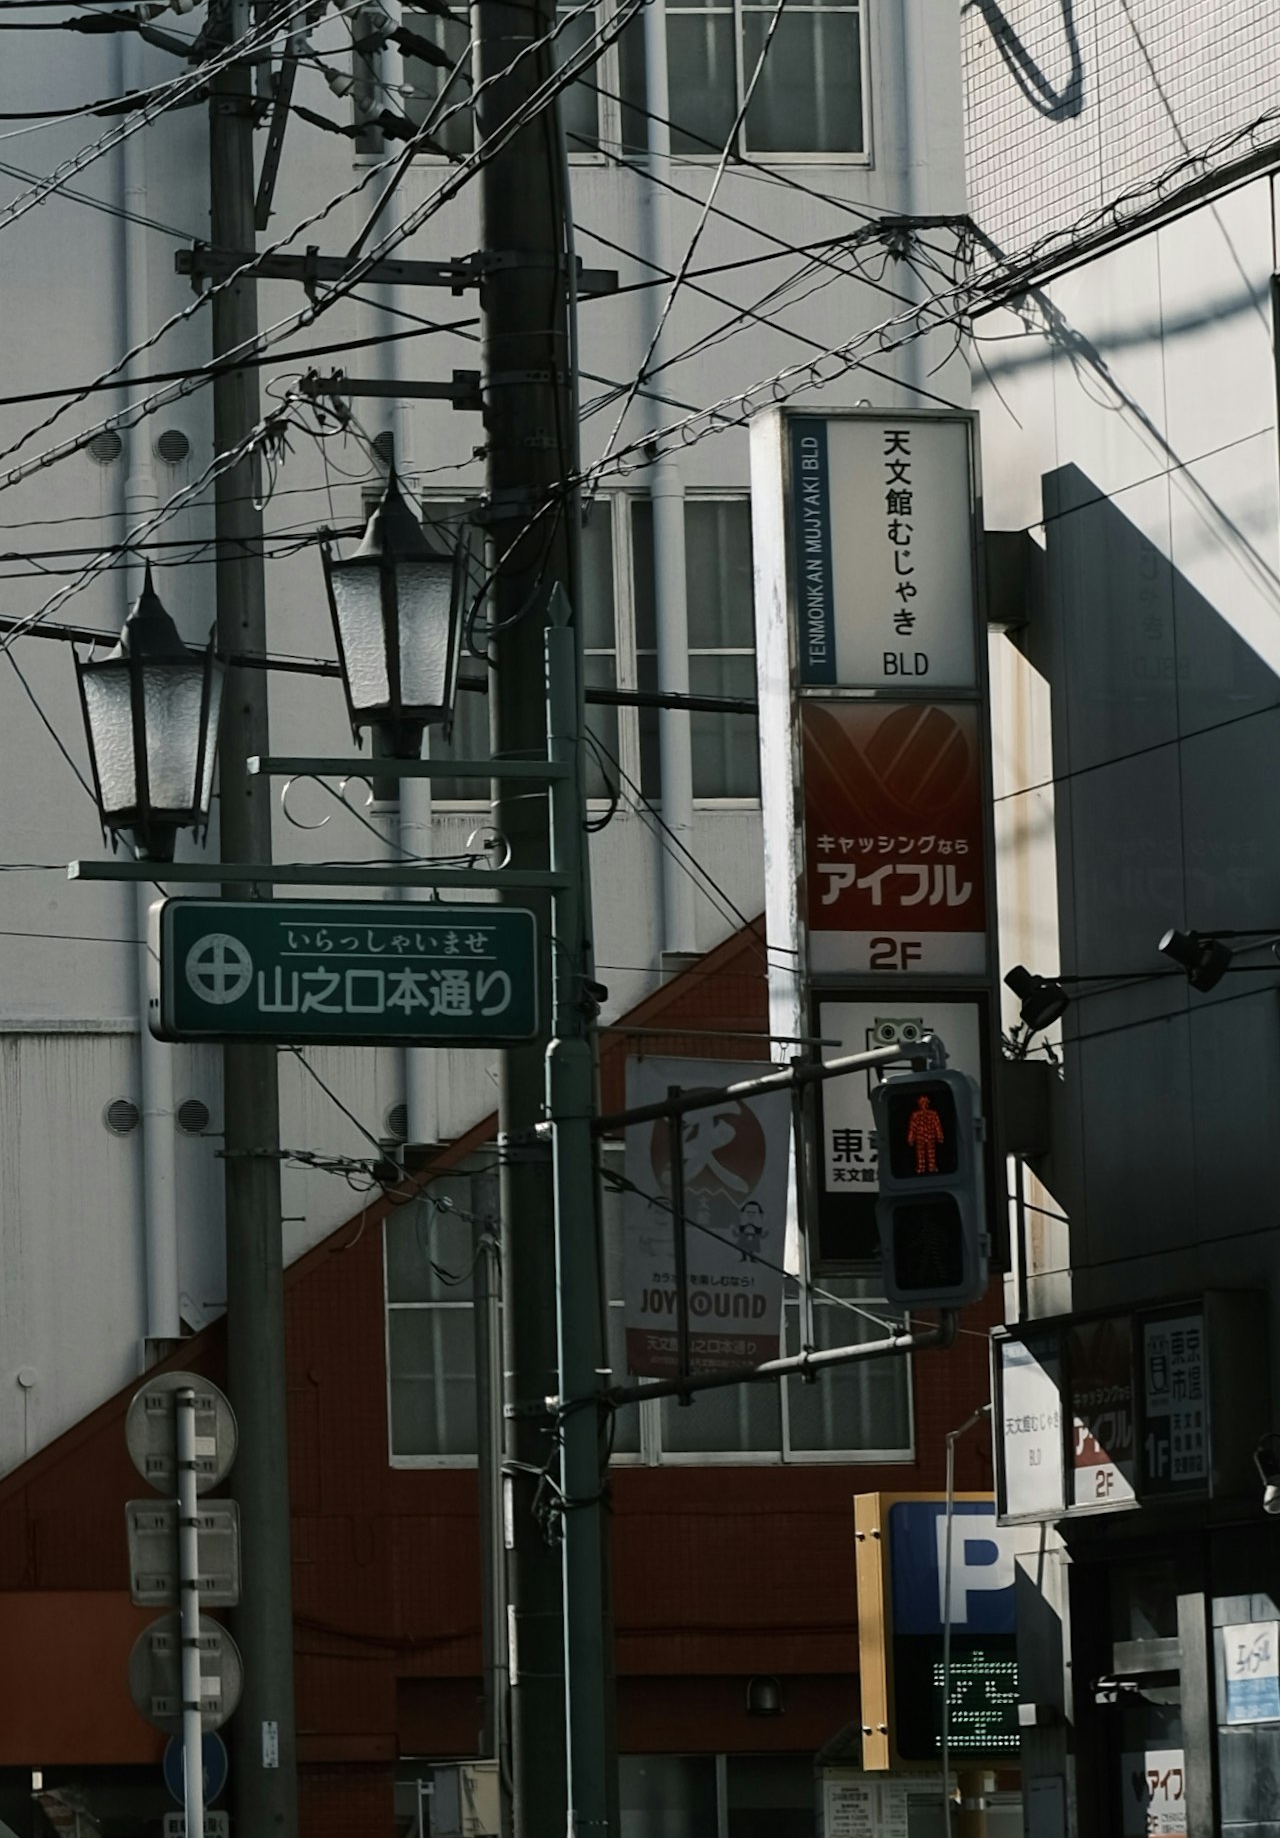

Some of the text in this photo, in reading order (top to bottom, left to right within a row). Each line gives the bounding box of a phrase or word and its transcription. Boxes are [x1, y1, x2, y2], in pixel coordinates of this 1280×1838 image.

[801, 436, 819, 470] BLD
[883, 429, 918, 636] 天文館むじゃき
[806, 568, 824, 667] TENMONKAN
[883, 651, 929, 677] BLD
[816, 832, 969, 856] キャッシングなら
[818, 863, 973, 908] アイフル
[286, 928, 490, 956] いらっしゃいませ
[869, 937, 922, 970] 2F
[255, 966, 512, 1018] 山之口本通り
[833, 1168, 879, 1182] 天文館
[651, 1271, 756, 1287] カラを楽しむなら!
[640, 1288, 767, 1319] JOYOUND
[1171, 1328, 1201, 1365] 東京
[1072, 1409, 1133, 1456] アイフル
[1144, 1433, 1170, 1479] 1F
[1095, 1469, 1114, 1497] 2F
[935, 1514, 1018, 1624] P
[932, 1650, 1021, 1747] 空
